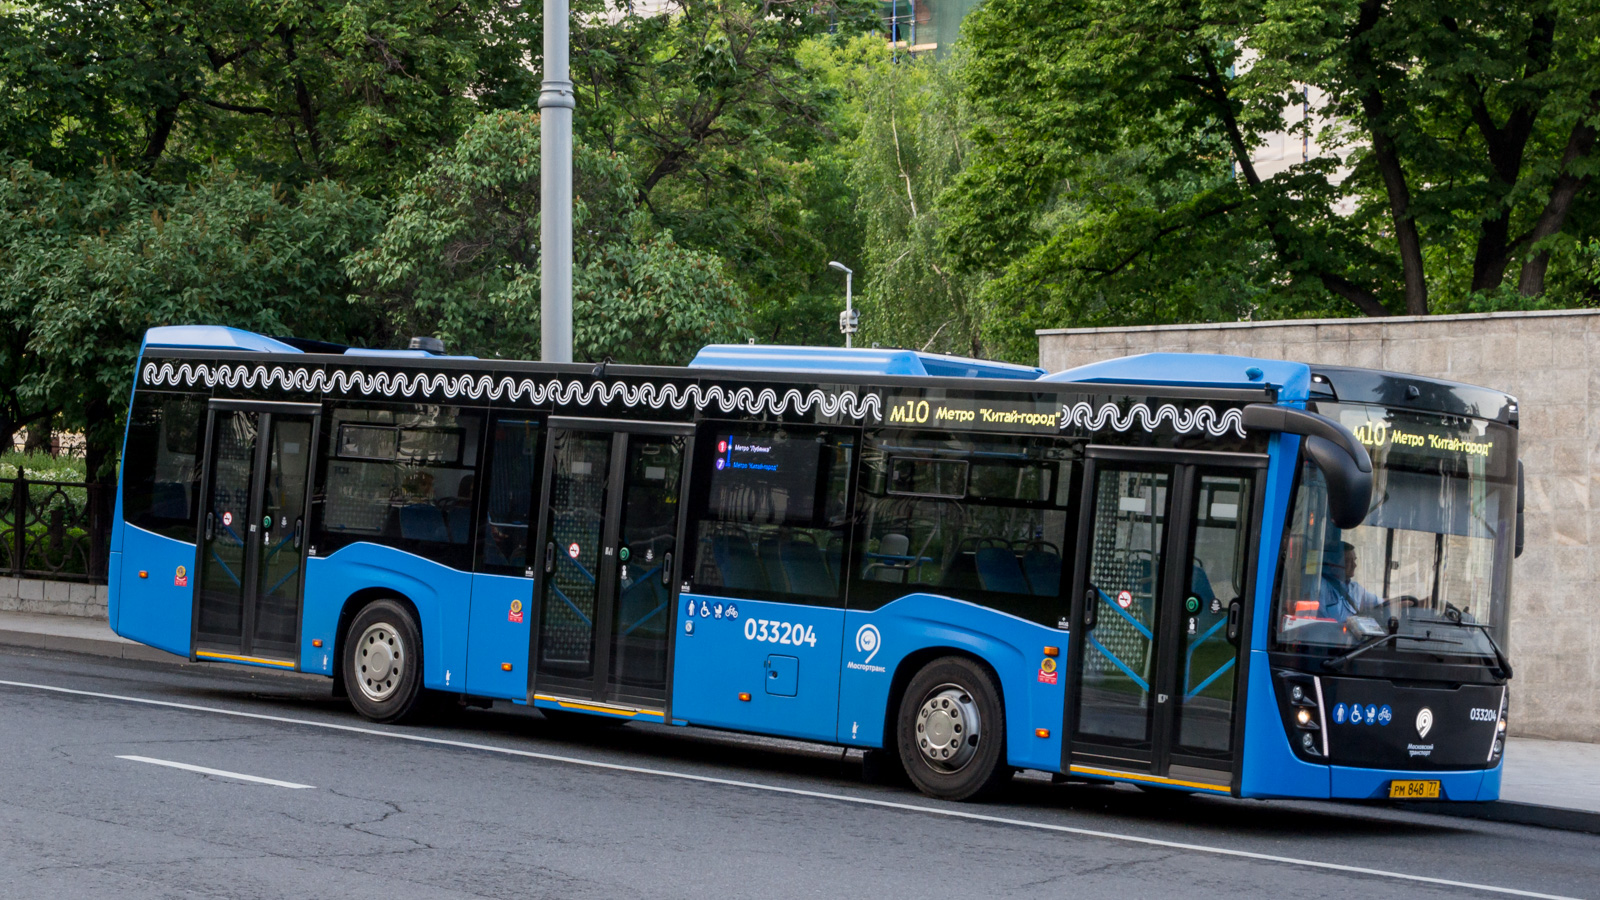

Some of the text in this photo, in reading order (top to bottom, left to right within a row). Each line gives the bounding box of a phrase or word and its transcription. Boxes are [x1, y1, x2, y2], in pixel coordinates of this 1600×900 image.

[935, 406, 975, 422] Метро
[979, 408, 1061, 427] "Китай-город"
[734, 444, 750, 452] Метро
[1391, 429, 1425, 447] Метро
[1427, 434, 1493, 456] "Китай-город"
[744, 617, 817, 648] 033204
[847, 661, 886, 673] Мосгортранс
[1470, 707, 1497, 722] 033204
[1408, 782, 1424, 796] 848
[1428, 781, 1438, 792] 77
